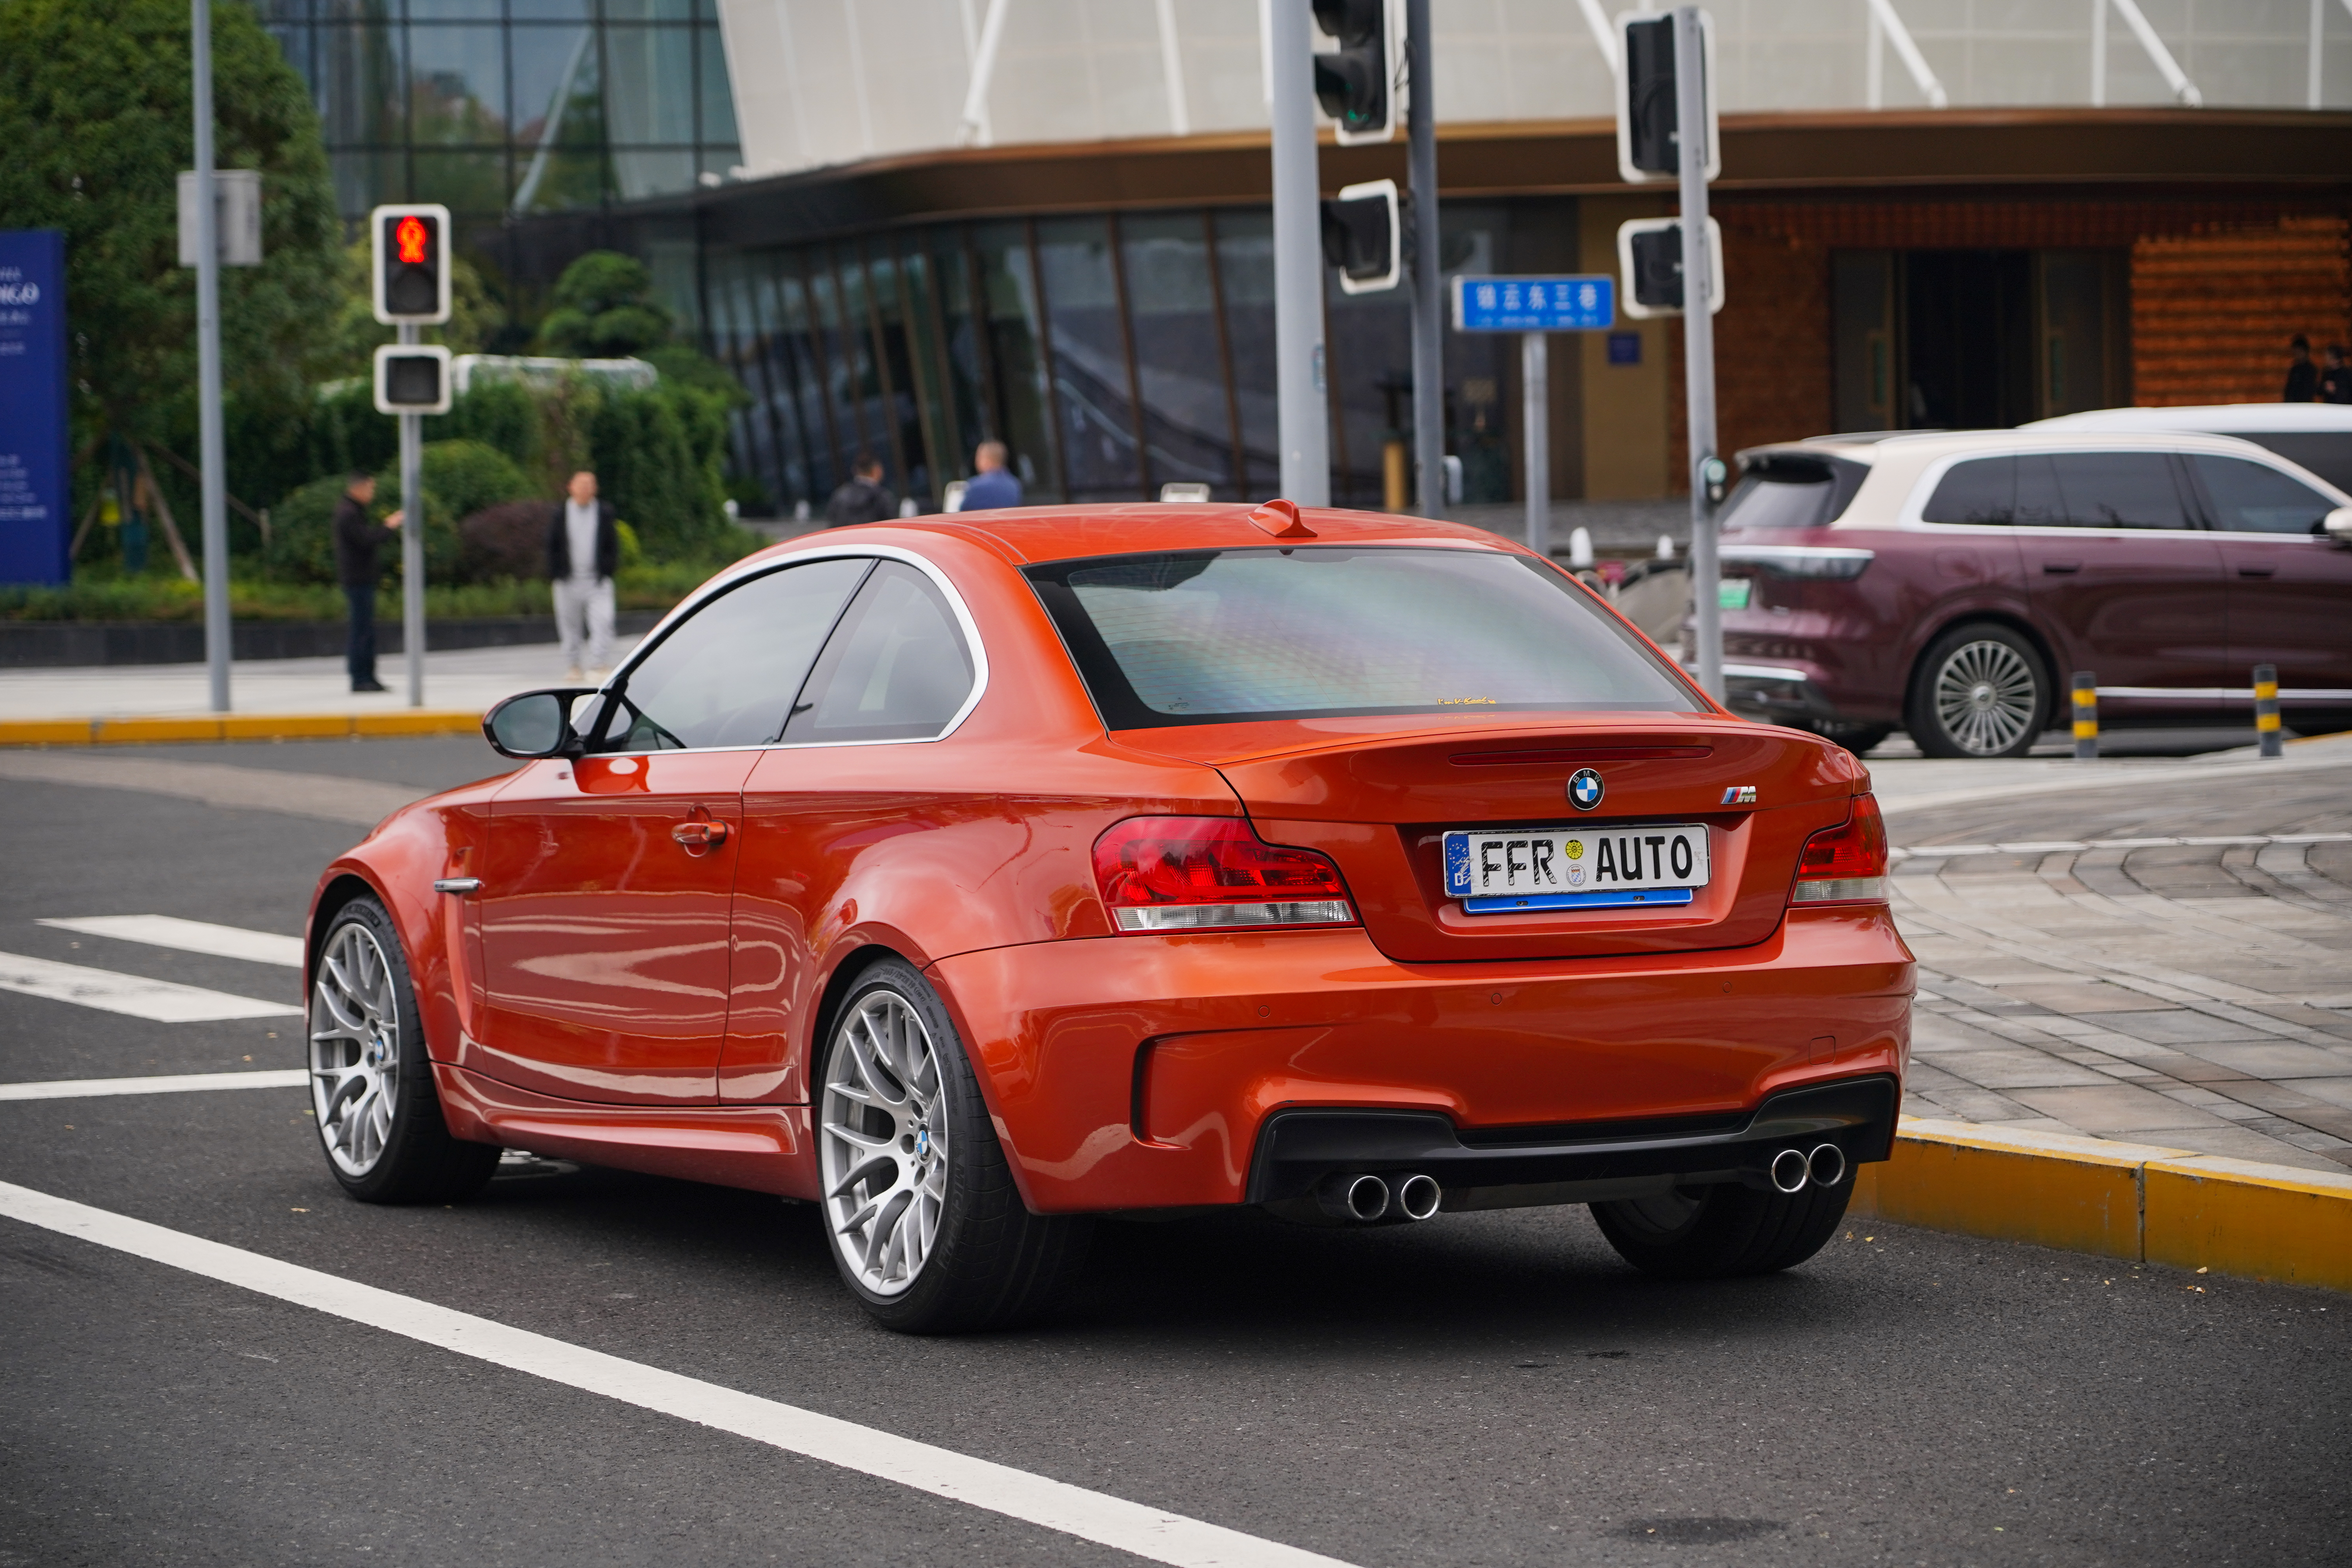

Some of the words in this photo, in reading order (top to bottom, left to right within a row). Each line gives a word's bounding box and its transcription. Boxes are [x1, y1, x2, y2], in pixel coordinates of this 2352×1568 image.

[1572, 770, 1601, 783] BMW
[1481, 840, 1557, 886] FFR
[1596, 835, 1692, 881] AUTO
[1454, 873, 1464, 886] D
